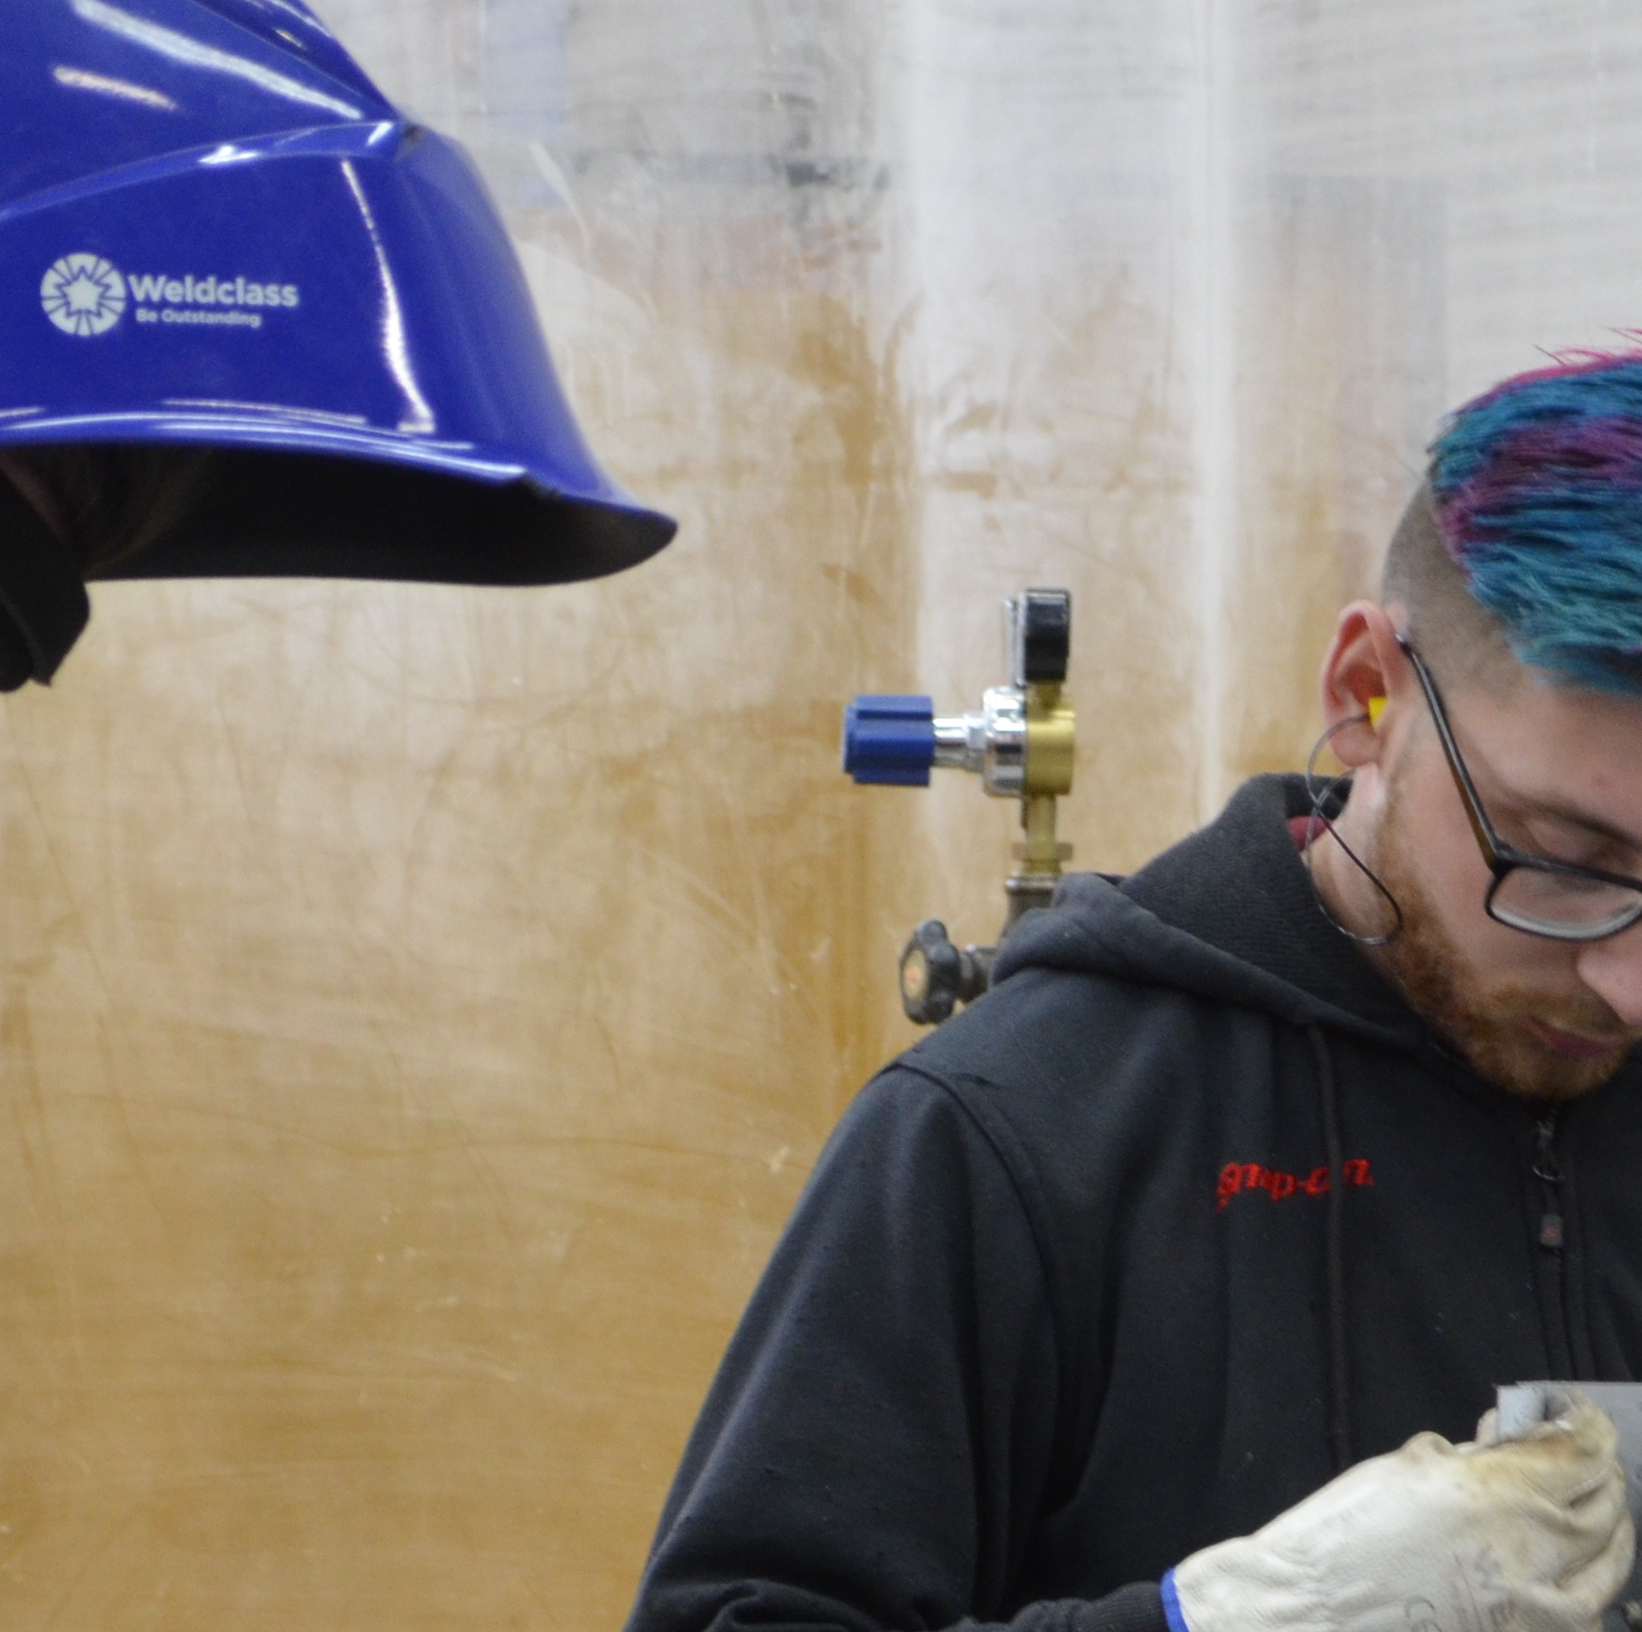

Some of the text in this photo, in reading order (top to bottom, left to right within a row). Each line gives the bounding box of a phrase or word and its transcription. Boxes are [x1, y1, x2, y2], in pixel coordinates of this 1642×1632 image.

[127, 272, 300, 307] Weldclass
[135, 307, 262, 328] Be Outstanding
